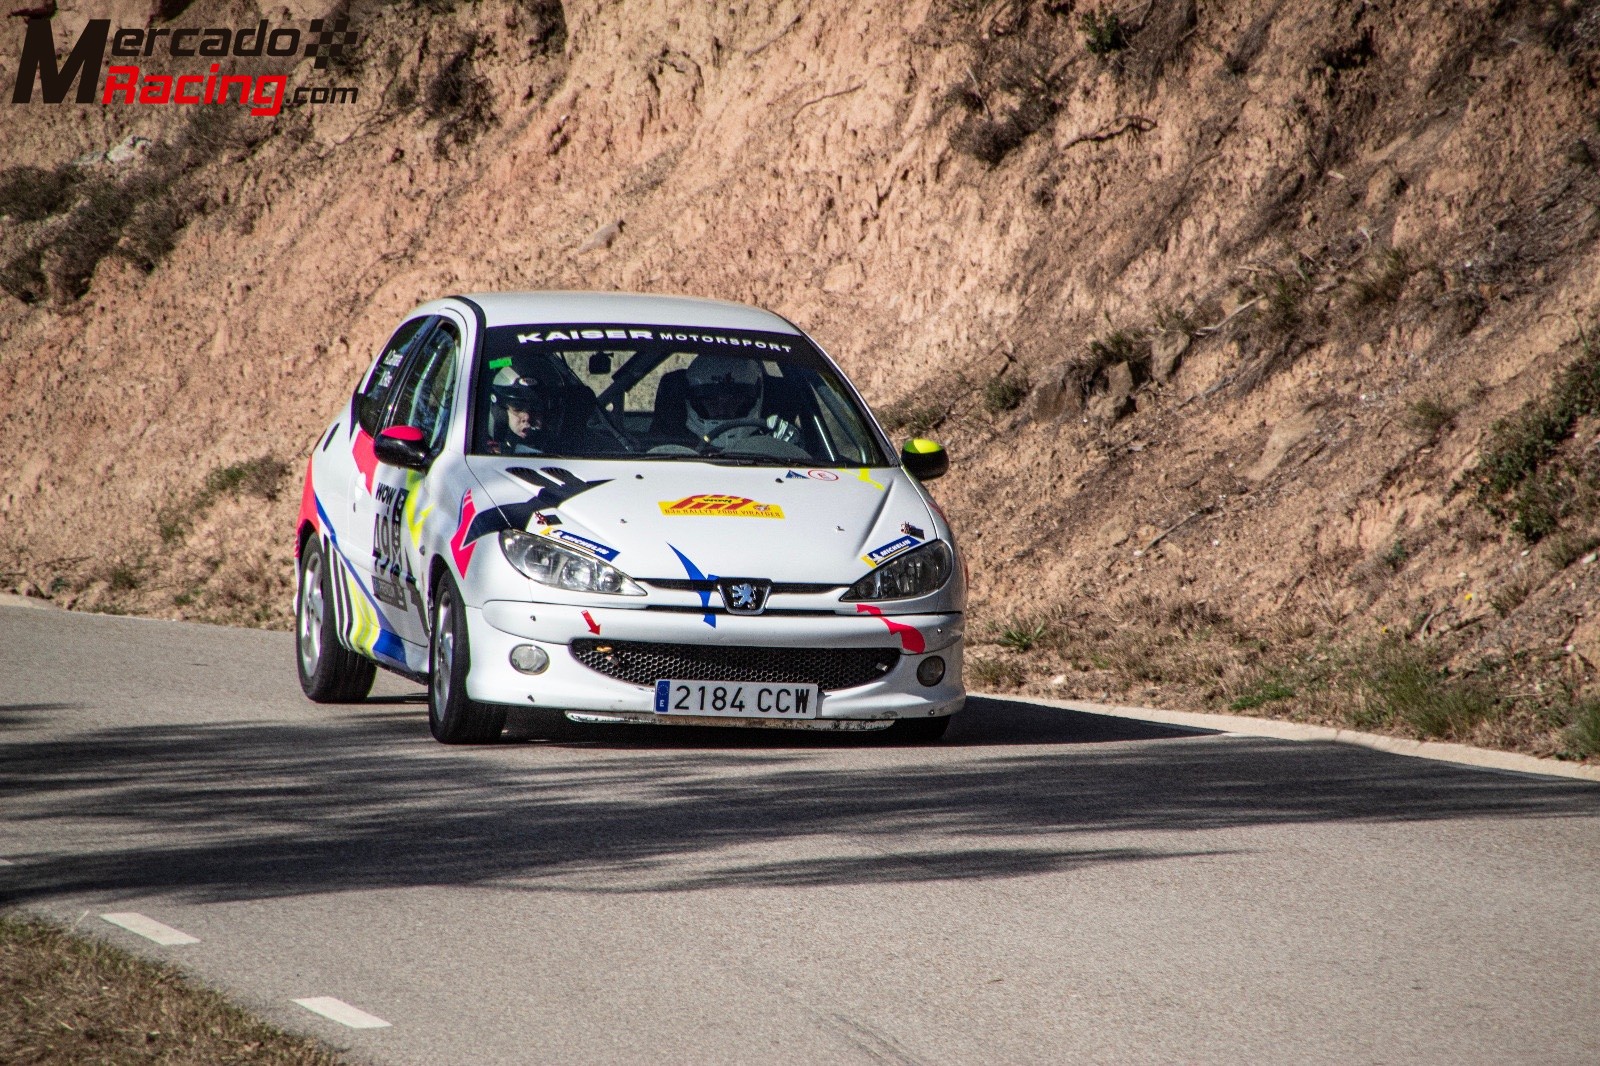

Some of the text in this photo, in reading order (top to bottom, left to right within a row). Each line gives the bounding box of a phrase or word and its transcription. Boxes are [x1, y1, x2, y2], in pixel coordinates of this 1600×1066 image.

[517, 329, 792, 353] KAISER MOTORSPORT
[375, 482, 396, 505] WOW
[561, 535, 609, 555] MICHELIN
[880, 539, 911, 557] MICHELIN
[659, 699, 665, 707] E
[674, 685, 810, 714] 2184 CCW
